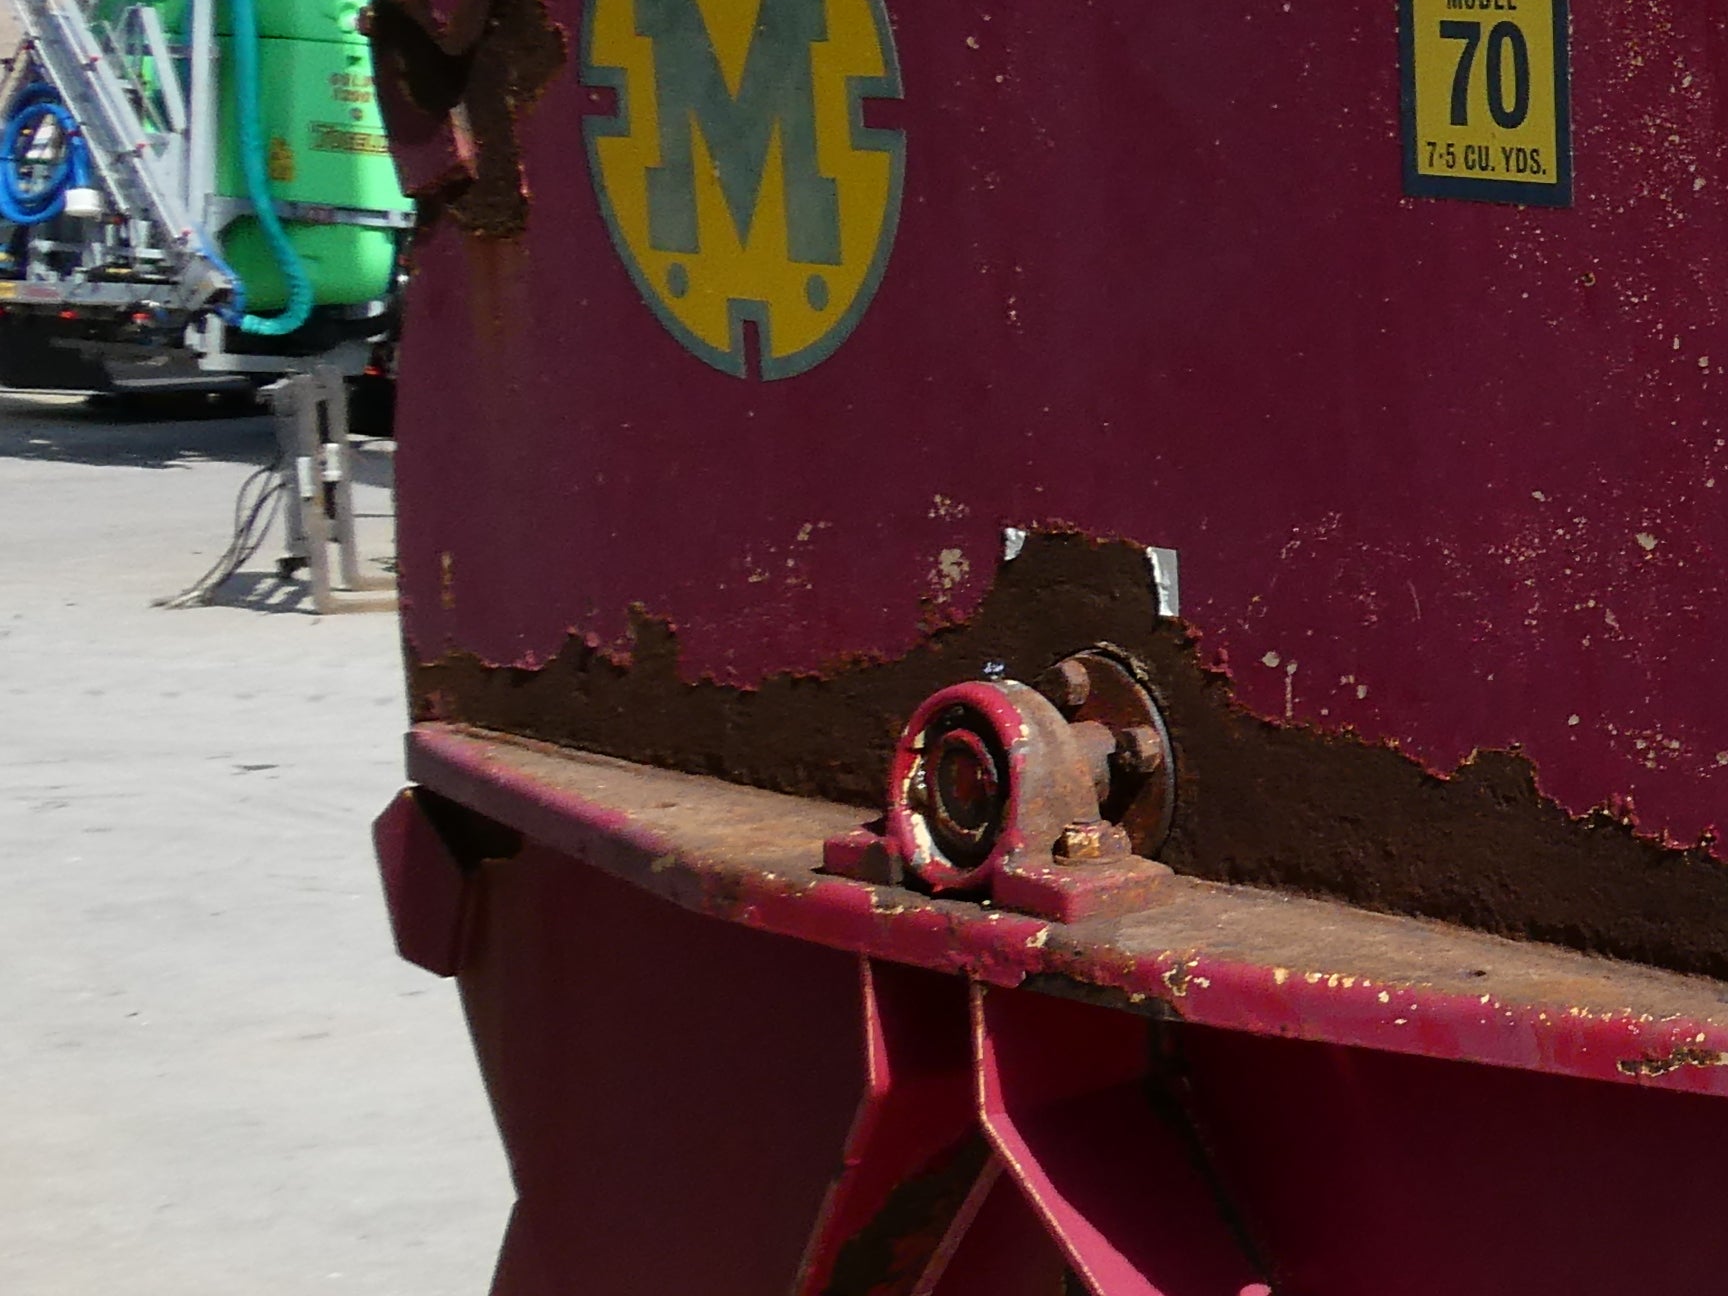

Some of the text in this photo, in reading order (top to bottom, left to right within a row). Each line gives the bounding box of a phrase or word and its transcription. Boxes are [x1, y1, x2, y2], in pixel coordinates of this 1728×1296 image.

[1439, 20, 1531, 130] 70
[1464, 143, 1496, 172] CU.
[1501, 146, 1547, 176] YDS.
